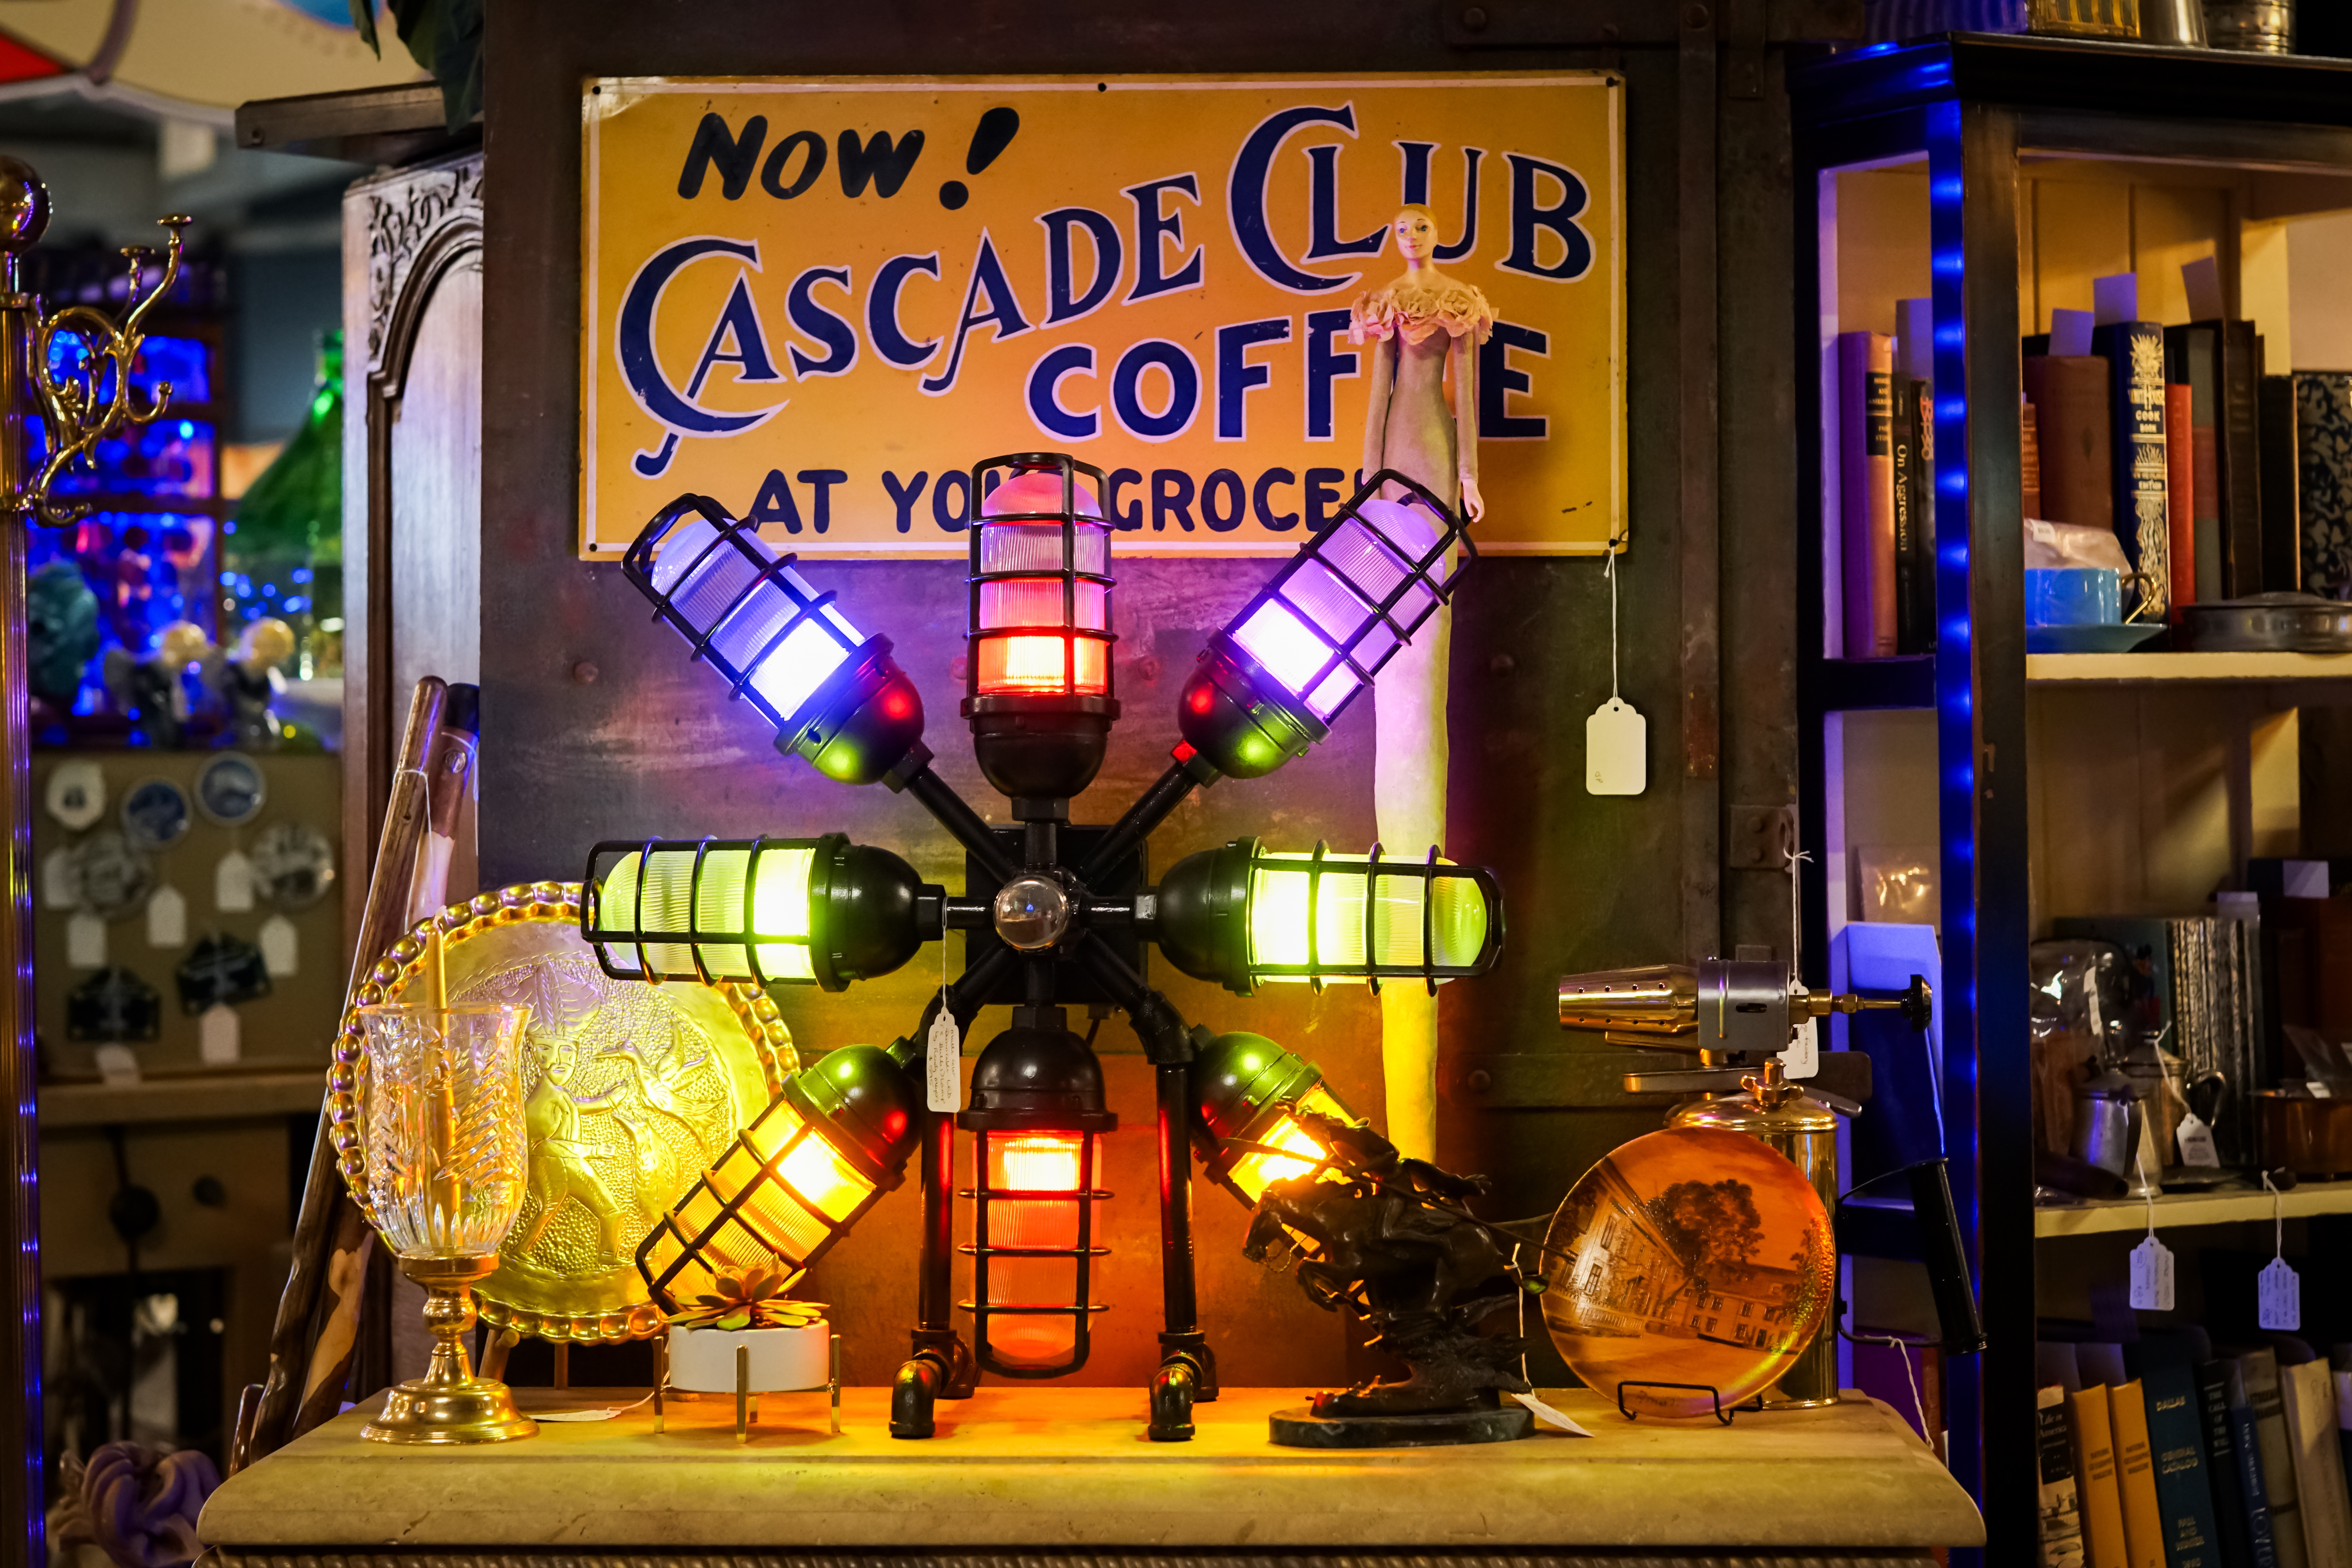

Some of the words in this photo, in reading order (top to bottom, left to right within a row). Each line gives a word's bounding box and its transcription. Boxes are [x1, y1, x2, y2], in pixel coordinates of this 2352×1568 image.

[616, 170, 1204, 479] CASCADE
[1227, 100, 1597, 296] CLUB
[1025, 306, 1551, 444] COFFE
[2135, 410, 2161, 422] COOK
[1897, 443, 1908, 468] On
[749, 469, 848, 533] AT
[882, 470, 1063, 533] YO
[1109, 469, 1472, 533] GROCE
[1896, 475, 1908, 552] Aggression
[2251, 1506, 2274, 1568] LOVER
